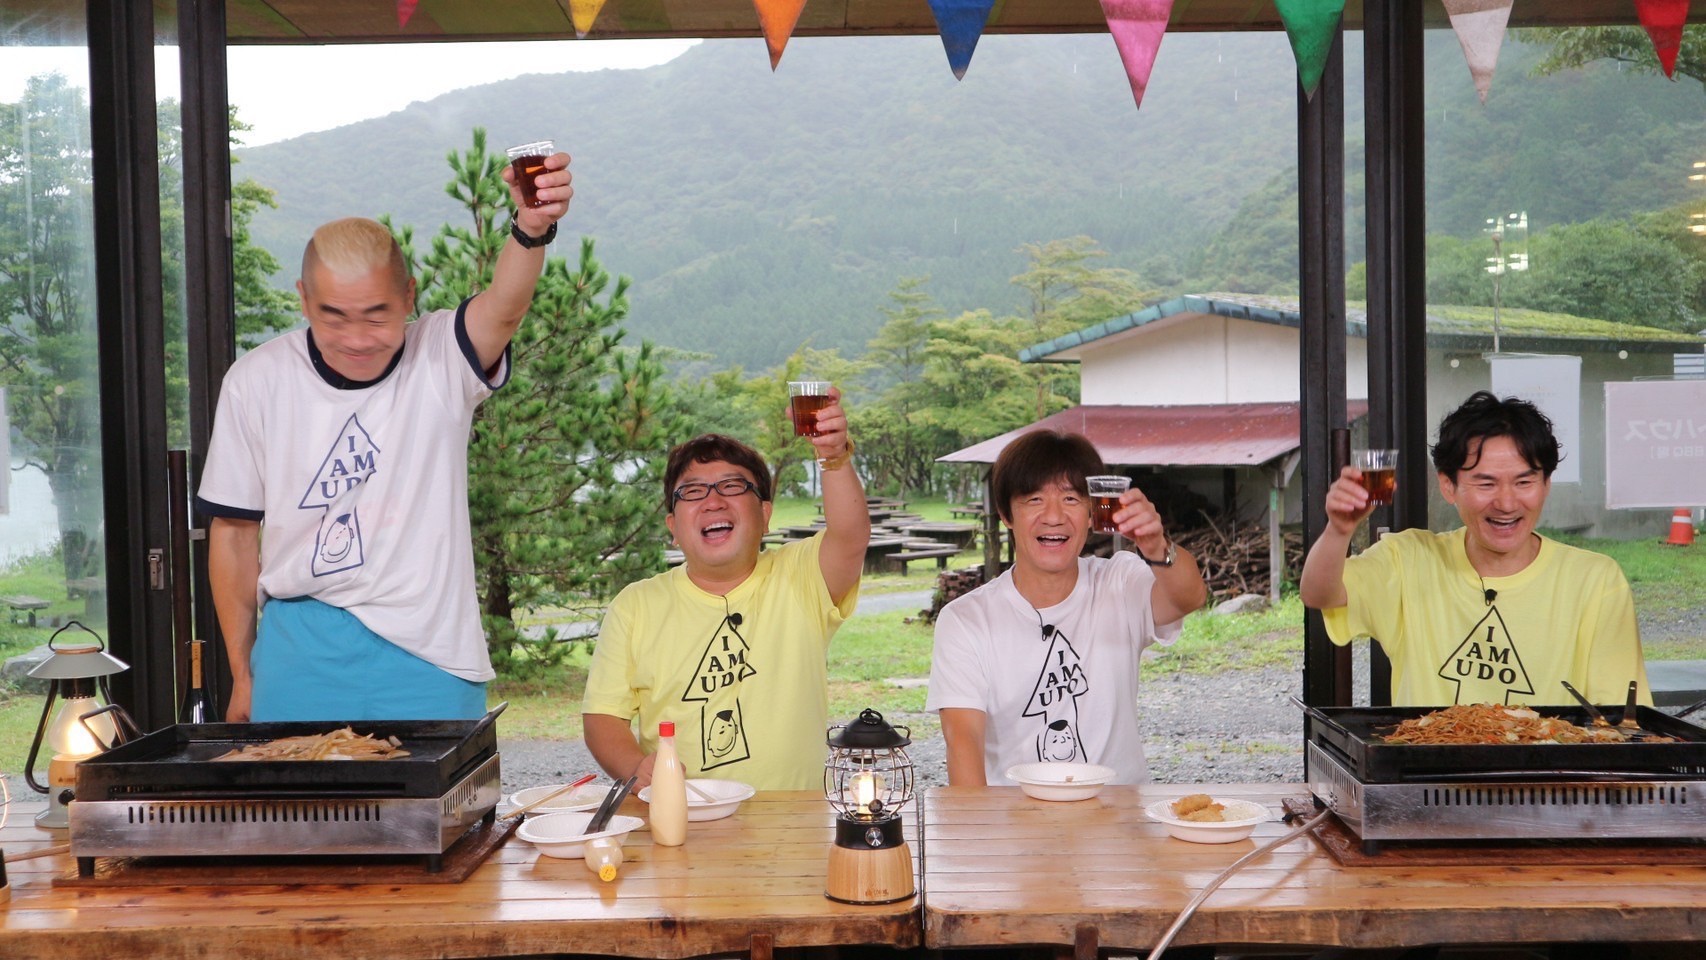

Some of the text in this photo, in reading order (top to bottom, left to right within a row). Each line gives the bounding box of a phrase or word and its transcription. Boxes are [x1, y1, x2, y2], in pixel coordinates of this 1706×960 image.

[347, 435, 356, 453] I
[329, 450, 376, 477] AM
[320, 473, 370, 499] UD
[721, 635, 730, 651] I
[1485, 625, 1495, 643] I
[708, 649, 746, 673] AM
[1057, 650, 1065, 666] I
[1466, 641, 1511, 665] AM
[1456, 658, 1517, 685] UDO
